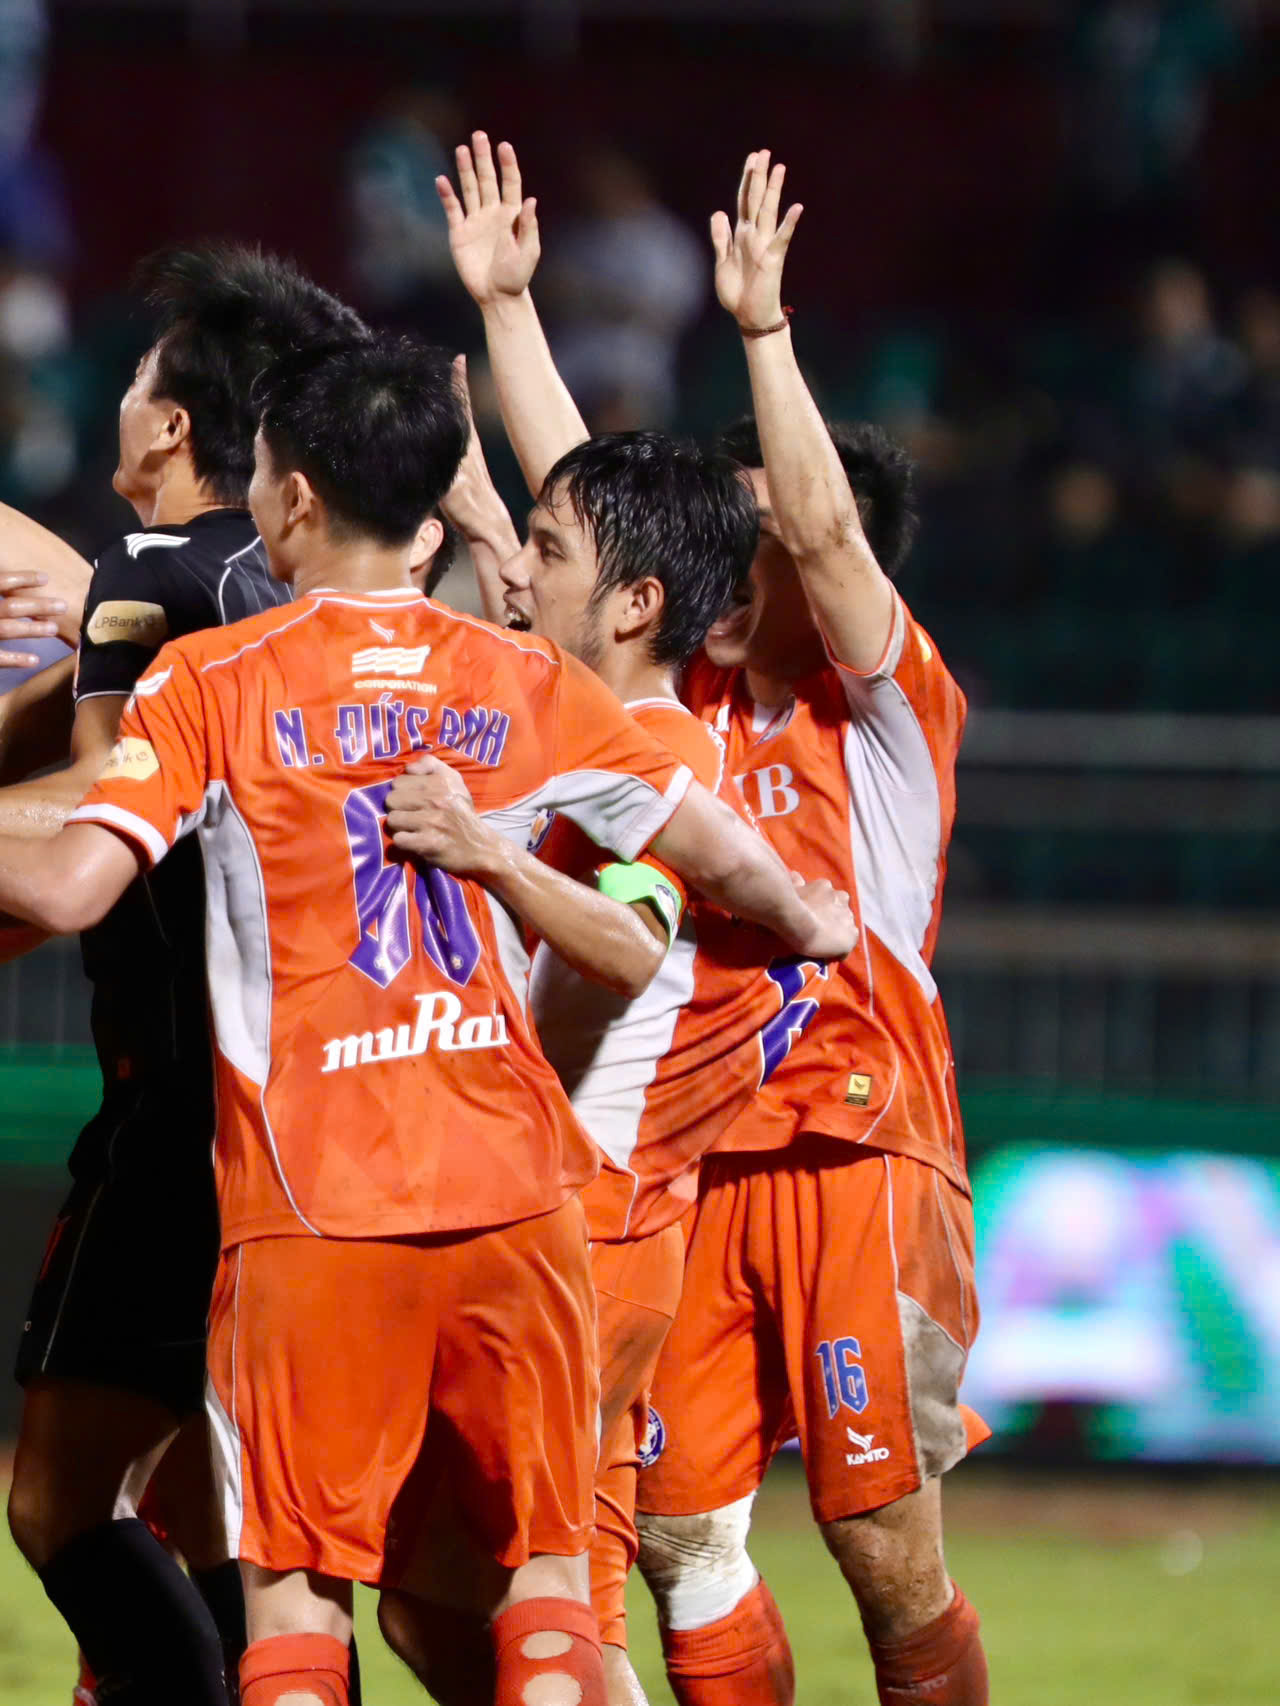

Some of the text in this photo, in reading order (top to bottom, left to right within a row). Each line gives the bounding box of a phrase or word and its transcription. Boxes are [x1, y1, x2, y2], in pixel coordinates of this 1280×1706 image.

[353, 679, 438, 694] CORPORATION
[273, 706, 324, 769] N.
[436, 705, 511, 768] ANH
[732, 763, 800, 819] B
[814, 1335, 870, 1420] 16
[845, 1447, 891, 1467] KAMITO
